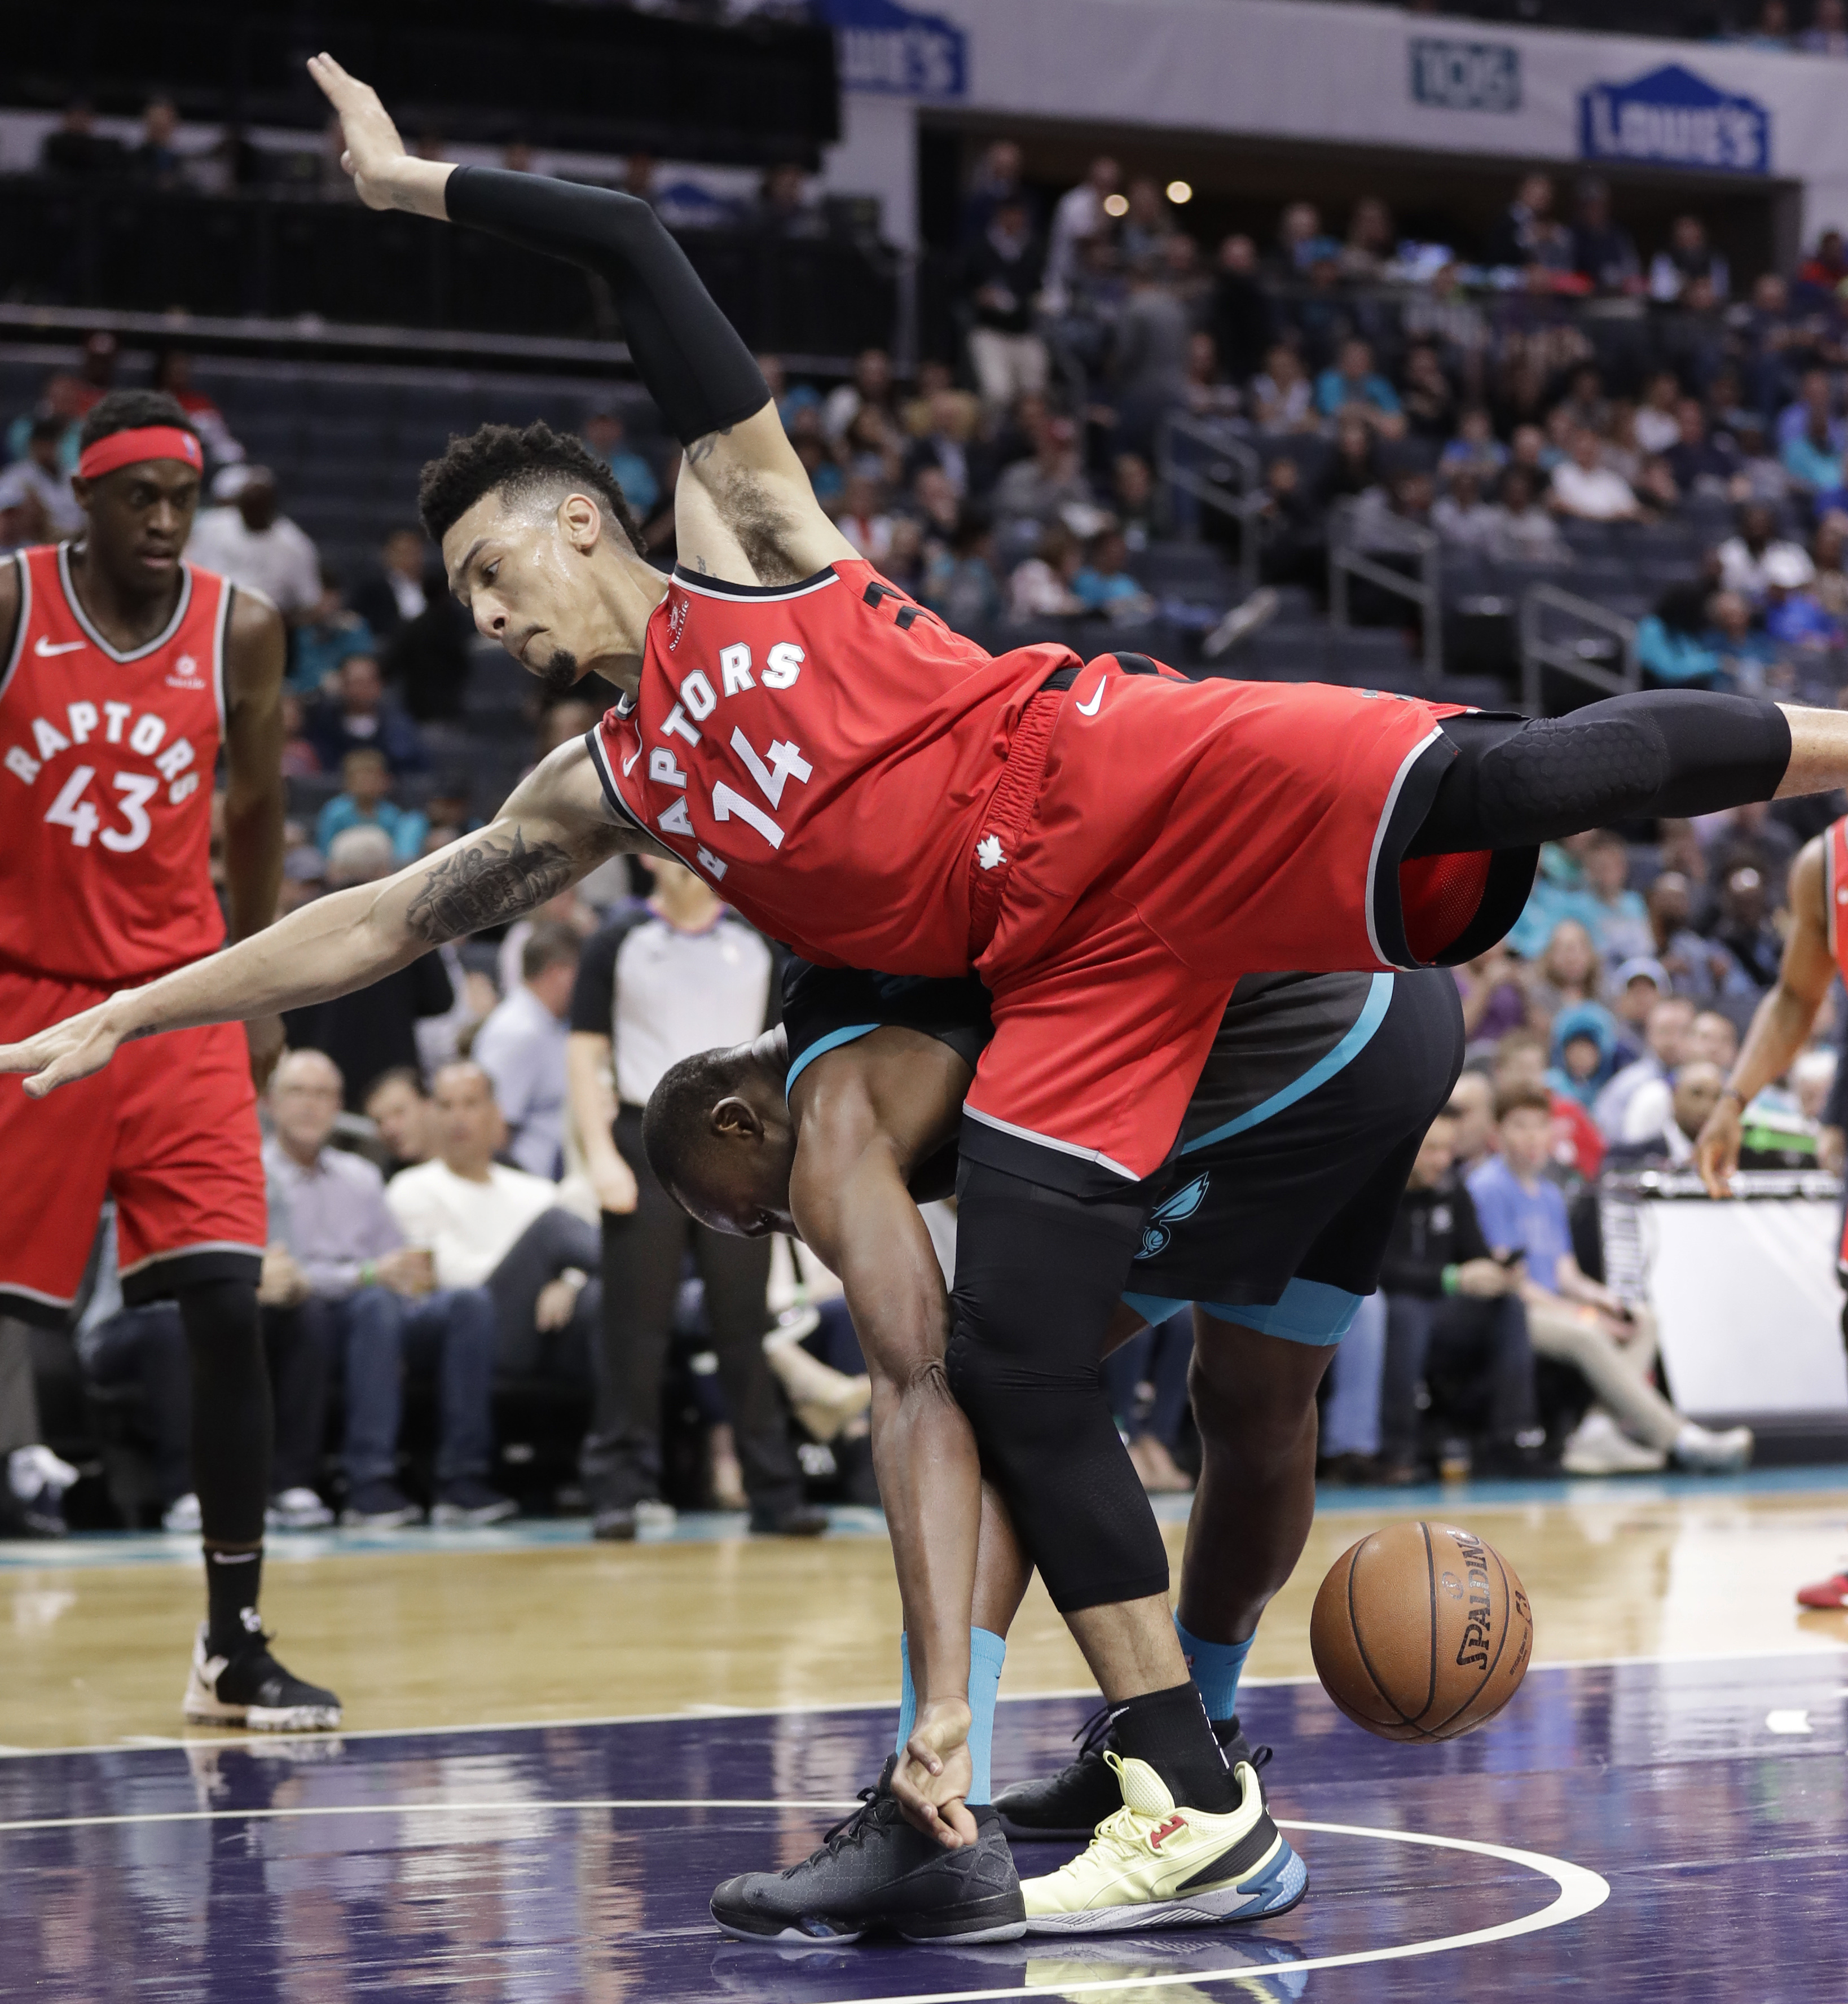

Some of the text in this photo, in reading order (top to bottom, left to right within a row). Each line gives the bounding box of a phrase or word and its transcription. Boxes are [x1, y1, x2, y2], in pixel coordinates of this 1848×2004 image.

[669, 600, 689, 651] Sun Life
[5, 701, 200, 805] RAPTORS
[649, 641, 806, 881] RAPTORS
[711, 725, 813, 850] 14
[44, 765, 159, 852] 43
